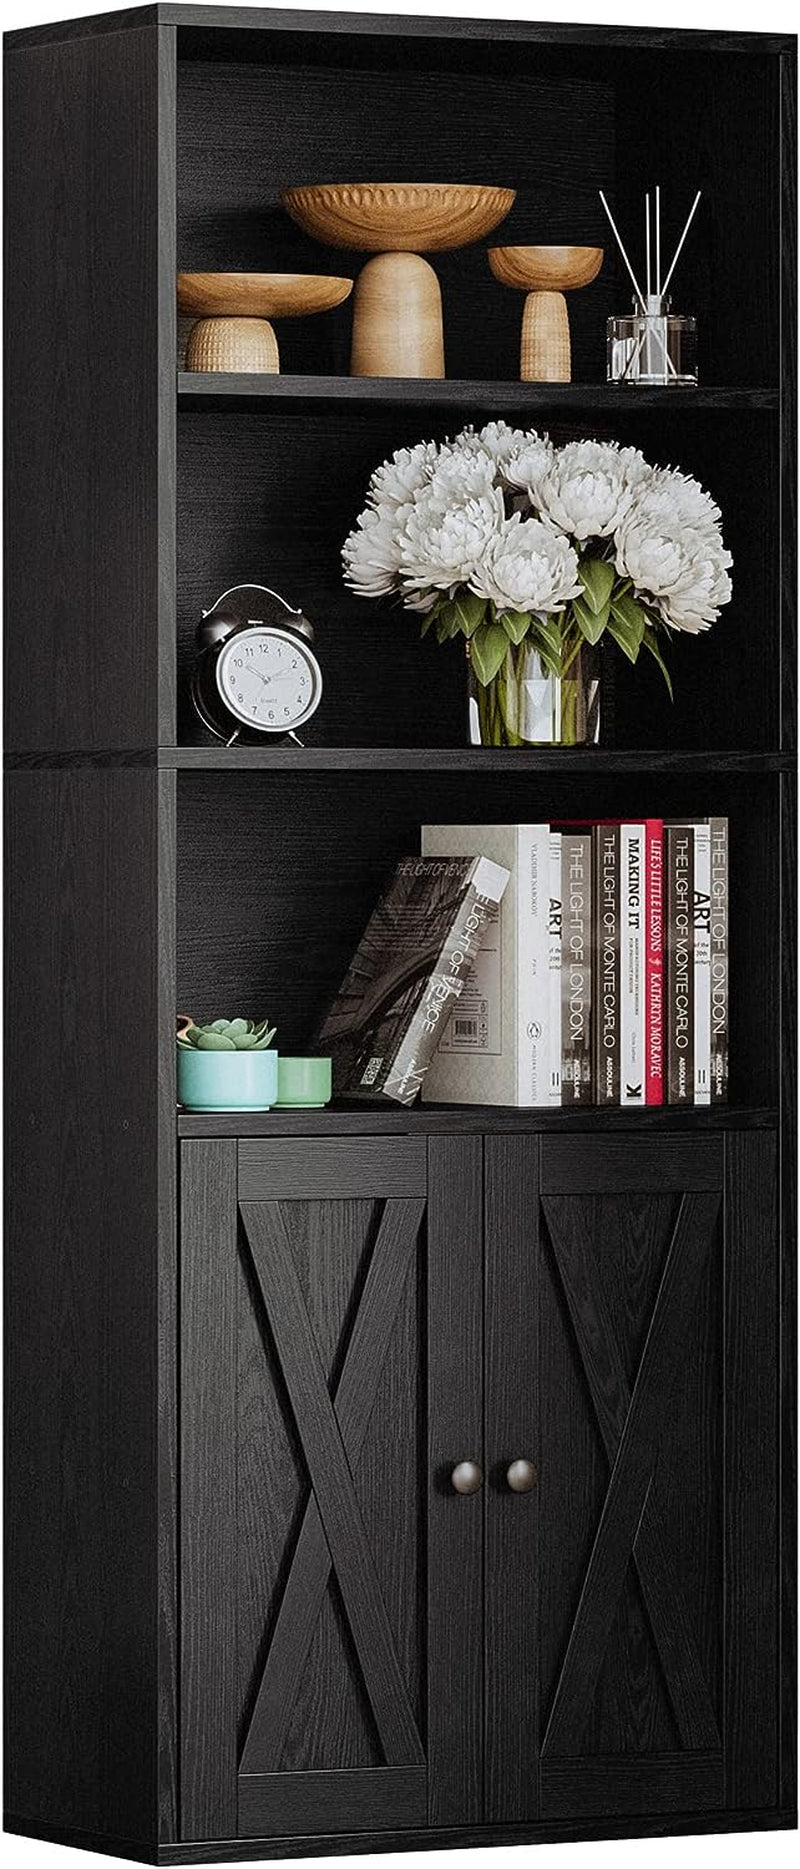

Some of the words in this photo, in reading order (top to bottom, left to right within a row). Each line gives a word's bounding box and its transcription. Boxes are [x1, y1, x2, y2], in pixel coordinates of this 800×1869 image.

[233, 658, 243, 668] 10
[245, 647, 254, 657] 11
[259, 643, 269, 654] 12
[277, 648, 282, 657] 1
[291, 659, 298, 669] 2
[229, 675, 236, 685] 9
[237, 693, 244, 703] 8
[299, 676, 306, 687] 3
[251, 705, 258, 716] 7
[267, 710, 275, 720] 6
[283, 707, 290, 717] 5
[296, 695, 303, 704] 4
[569, 844, 584, 879] THE
[603, 834, 616, 864] THE
[650, 839, 663, 869] LIFE'S
[675, 837, 689, 867] THE
[712, 827, 726, 864] THE
[603, 866, 616, 911] LIGHT
[628, 838, 640, 907] MAKING
[650, 870, 662, 907] LITTLE
[675, 869, 689, 912] LIGHT
[569, 882, 584, 933] LIGHT
[712, 867, 726, 921] LIGHT
[458, 902, 485, 953] LIGHT
[549, 898, 562, 940] ART
[603, 912, 616, 934] OF
[628, 911, 640, 930] IT
[650, 909, 662, 952] LESSONS
[675, 914, 689, 936] OF
[694, 890, 711, 935] ART
[569, 935, 584, 961] OF
[712, 923, 726, 950] OF
[449, 950, 465, 976] OF
[603, 936, 616, 993] MONTE
[675, 938, 689, 994] MONTE
[424, 974, 454, 1034] VENICE
[569, 963, 584, 1041] LONDON
[650, 973, 662, 1024] KATHRYN
[712, 953, 726, 1034] LONDON
[603, 994, 616, 1048] CARLO
[675, 995, 689, 1049] CARLO
[650, 1026, 662, 1079] MORAVEC
[606, 1056, 614, 1098] ASSOULINE
[678, 1056, 686, 1098] ASSOULINE
